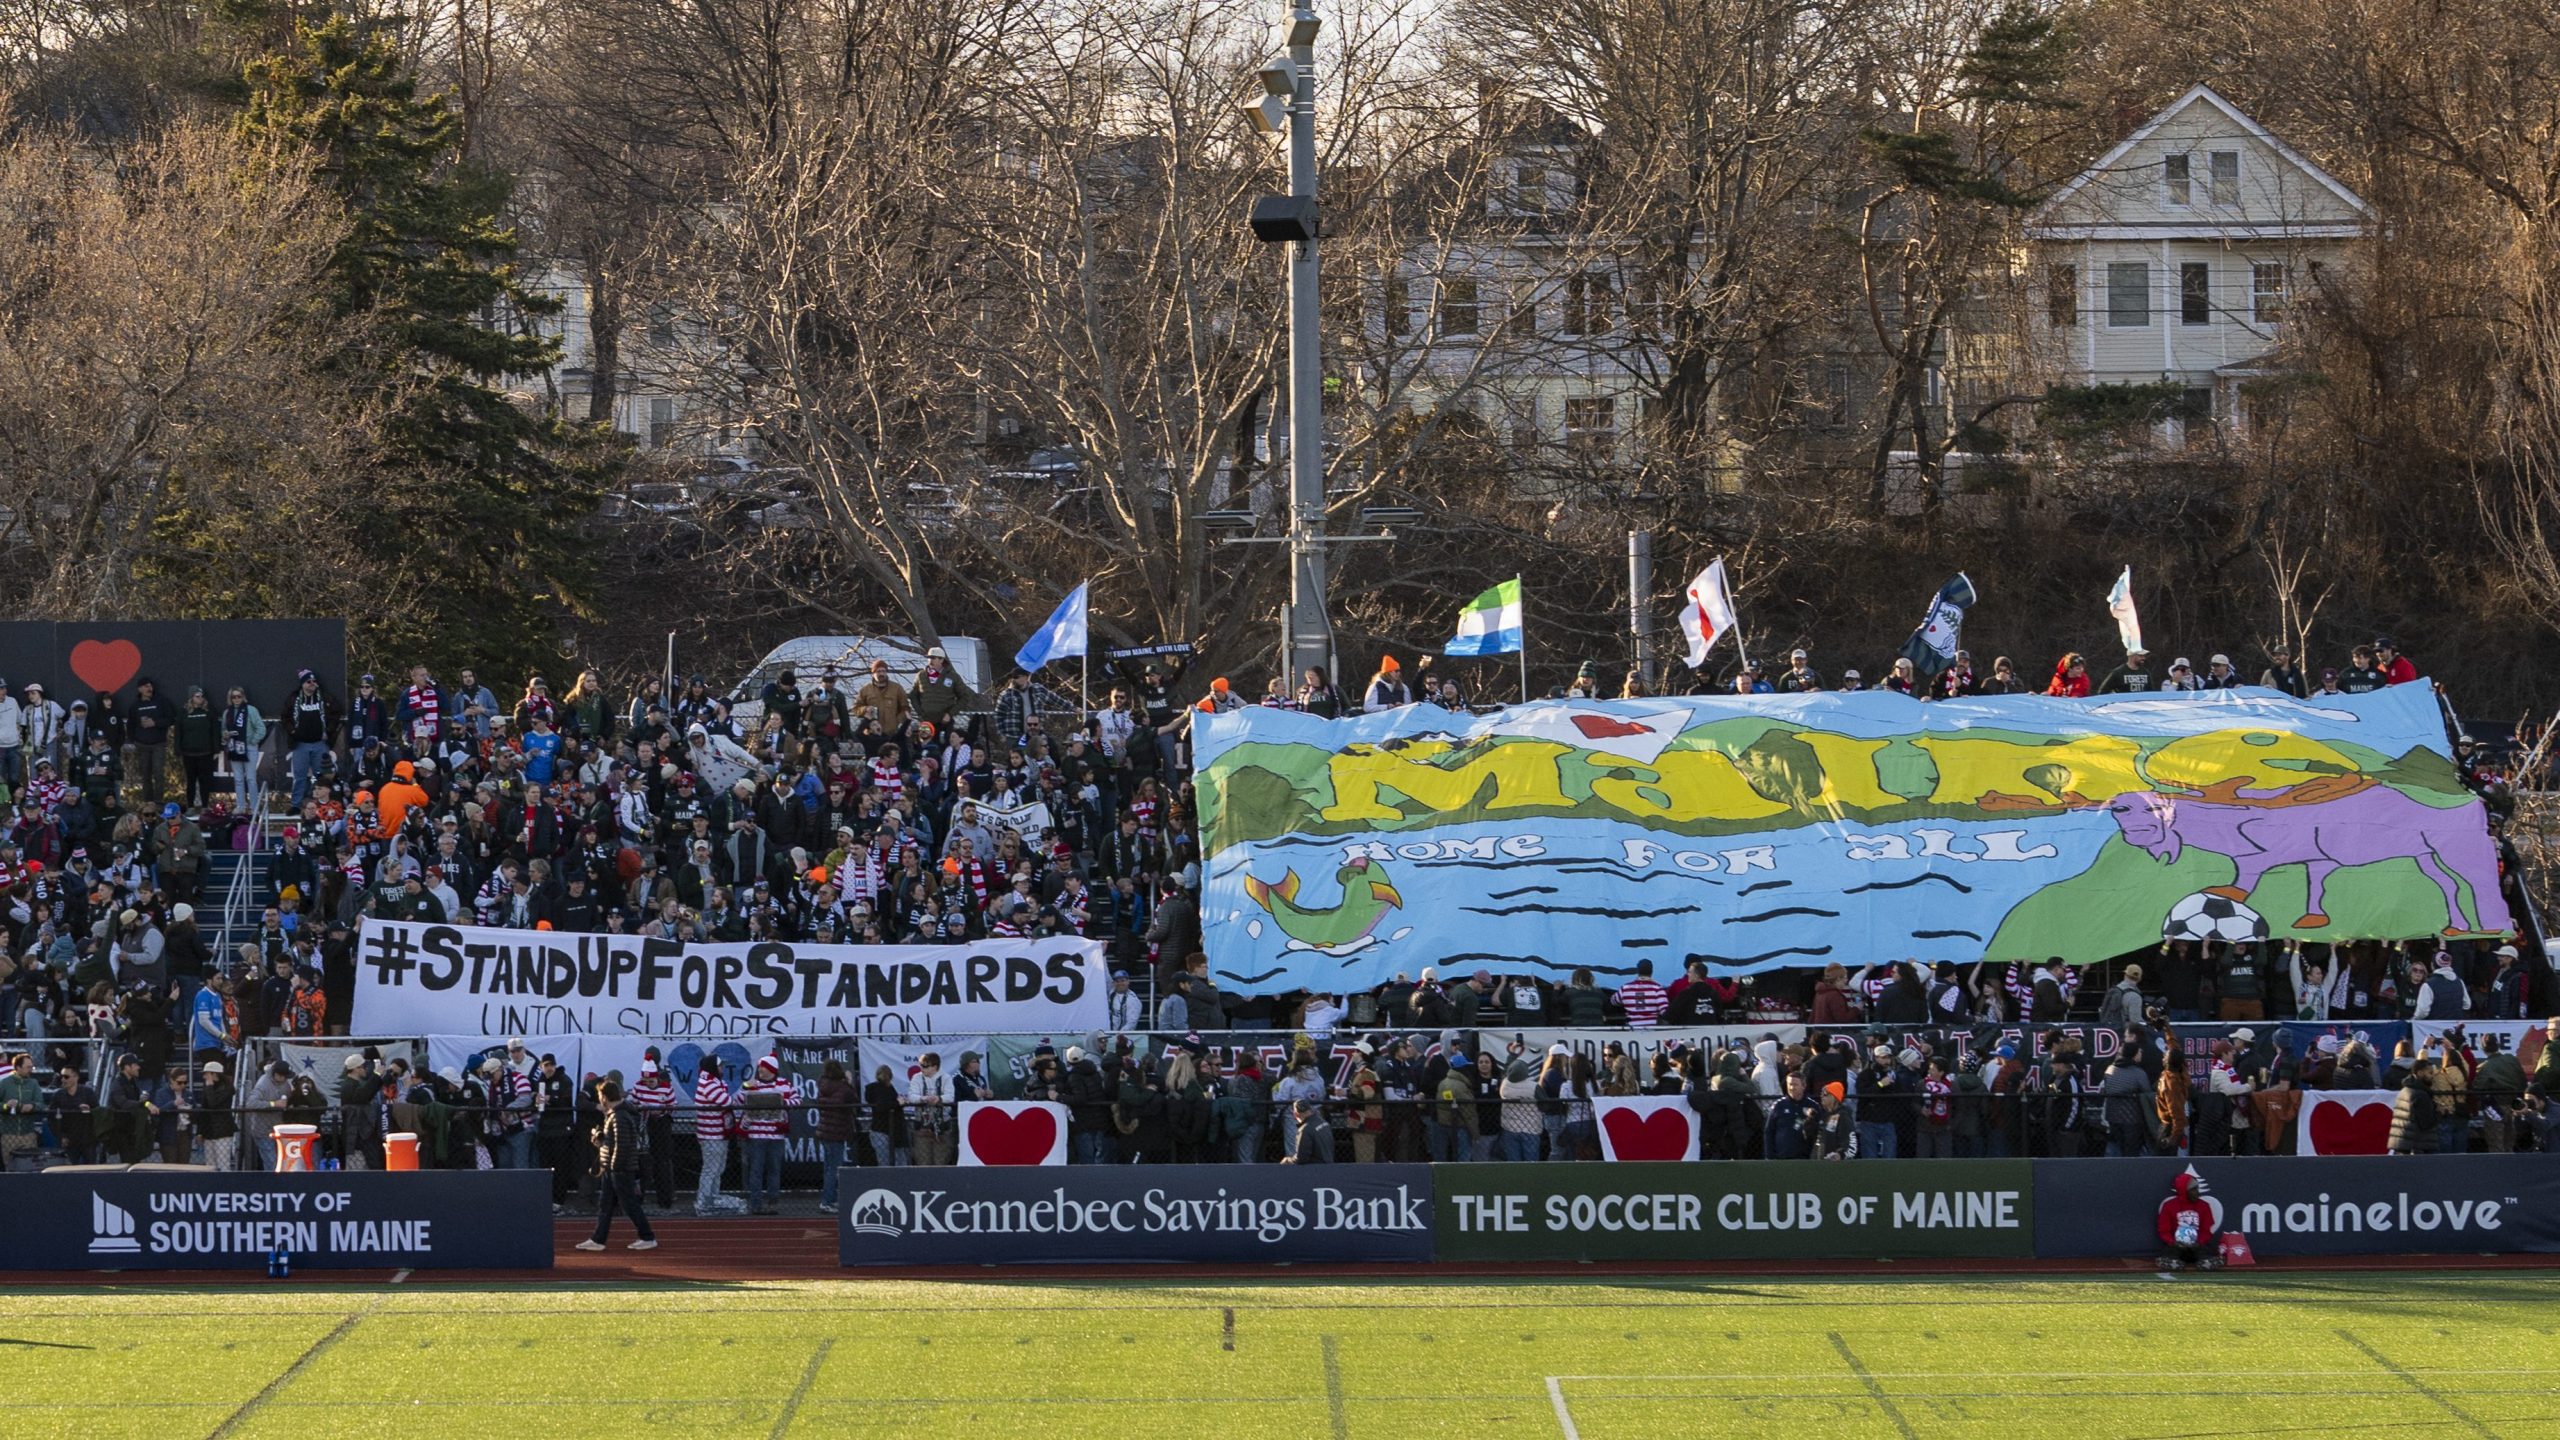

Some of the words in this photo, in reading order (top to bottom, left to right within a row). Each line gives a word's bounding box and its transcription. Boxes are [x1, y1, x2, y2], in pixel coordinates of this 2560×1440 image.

[1113, 650, 1132, 658] FROM
[1132, 646, 1155, 656] MAINE,
[1156, 645, 1173, 653] WITH
[1173, 643, 1190, 652] LOVE
[2123, 674, 2147, 684] FOREST
[2129, 684, 2144, 692] CITY
[1146, 699, 1168, 709] MAINE
[675, 812, 695, 820] MAIN
[380, 887, 407, 896] FOREST
[2231, 967, 2254, 976] MAINE
[150, 1192, 306, 1213] UNIVERSITY
[314, 1192, 352, 1213] OF
[910, 1187, 1137, 1234] Kennebec
[1143, 1188, 1306, 1243] Savings
[1313, 1184, 1427, 1231] Bank
[1452, 1194, 1529, 1231] THE
[1545, 1193, 1701, 1231] SOCCER
[1717, 1192, 1823, 1231] CLUB
[1837, 1196, 1878, 1226] OF
[1893, 1191, 2020, 1229] MAINE
[2242, 1192, 2503, 1233] mainelove
[150, 1220, 318, 1253] SOUTHERN
[330, 1219, 432, 1253] MAINE
